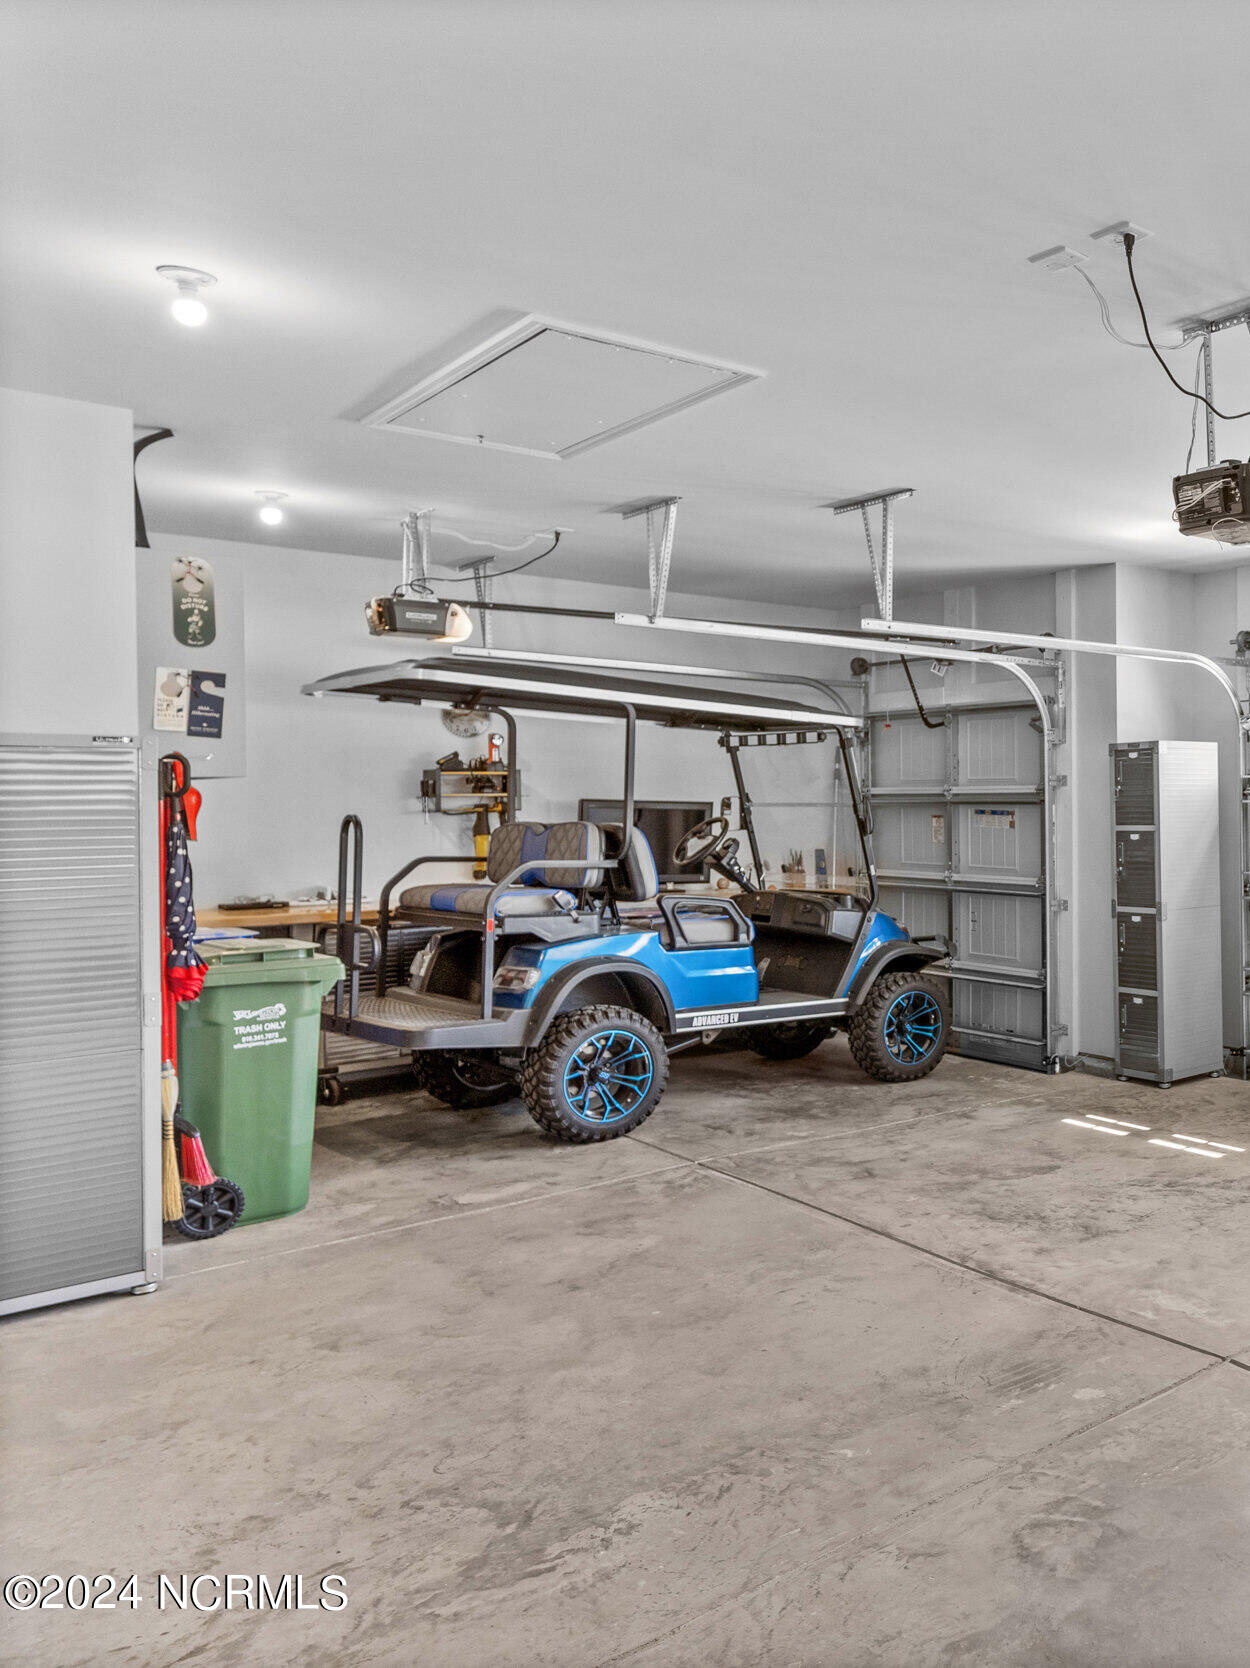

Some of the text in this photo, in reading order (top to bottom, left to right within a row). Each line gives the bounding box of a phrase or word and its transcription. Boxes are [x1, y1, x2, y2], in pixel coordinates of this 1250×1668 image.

[692, 1013, 739, 1027] ADVANCED EV
[233, 1020, 286, 1035] TRASH ONLY
